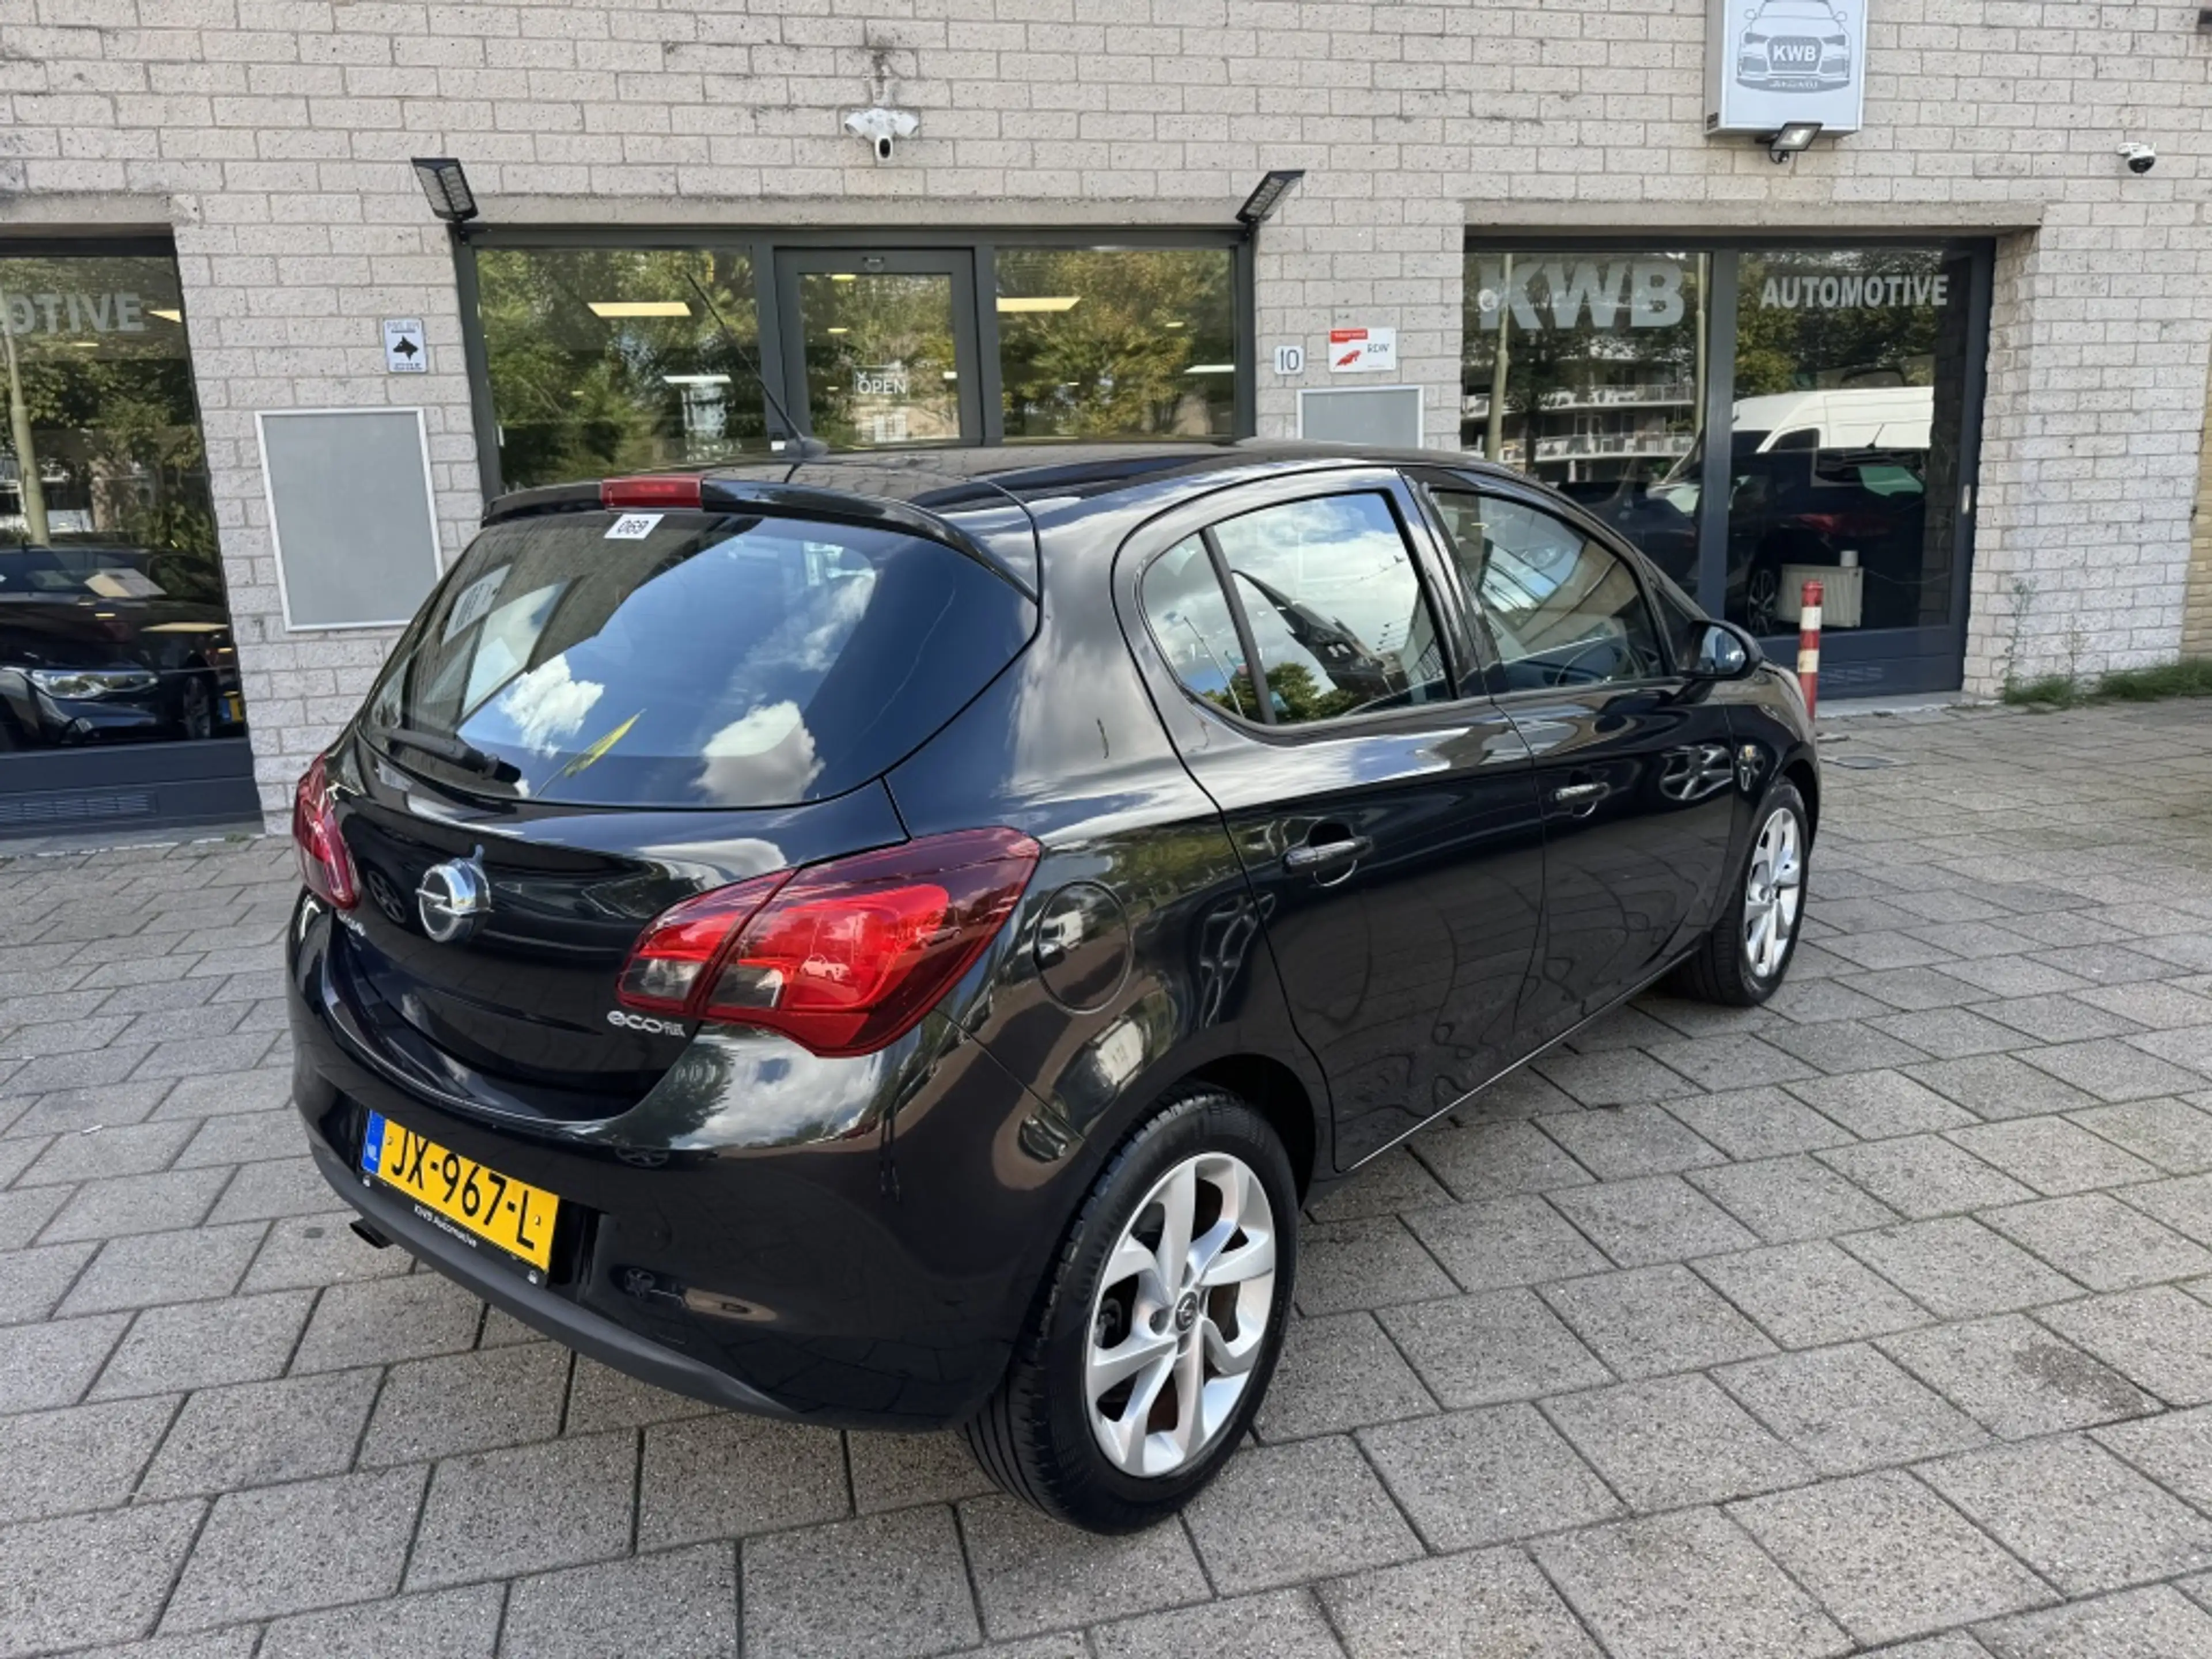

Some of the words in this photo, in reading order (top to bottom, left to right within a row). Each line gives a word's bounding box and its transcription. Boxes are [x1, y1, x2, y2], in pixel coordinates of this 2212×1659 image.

[1773, 44, 1816, 62] KWB
[1479, 262, 1685, 329] KWB
[1760, 274, 1950, 309] AUTOMOTIVE
[1280, 349, 1300, 371] 10
[858, 378, 906, 395] OPEN
[391, 1128, 535, 1251] JX-967-L
